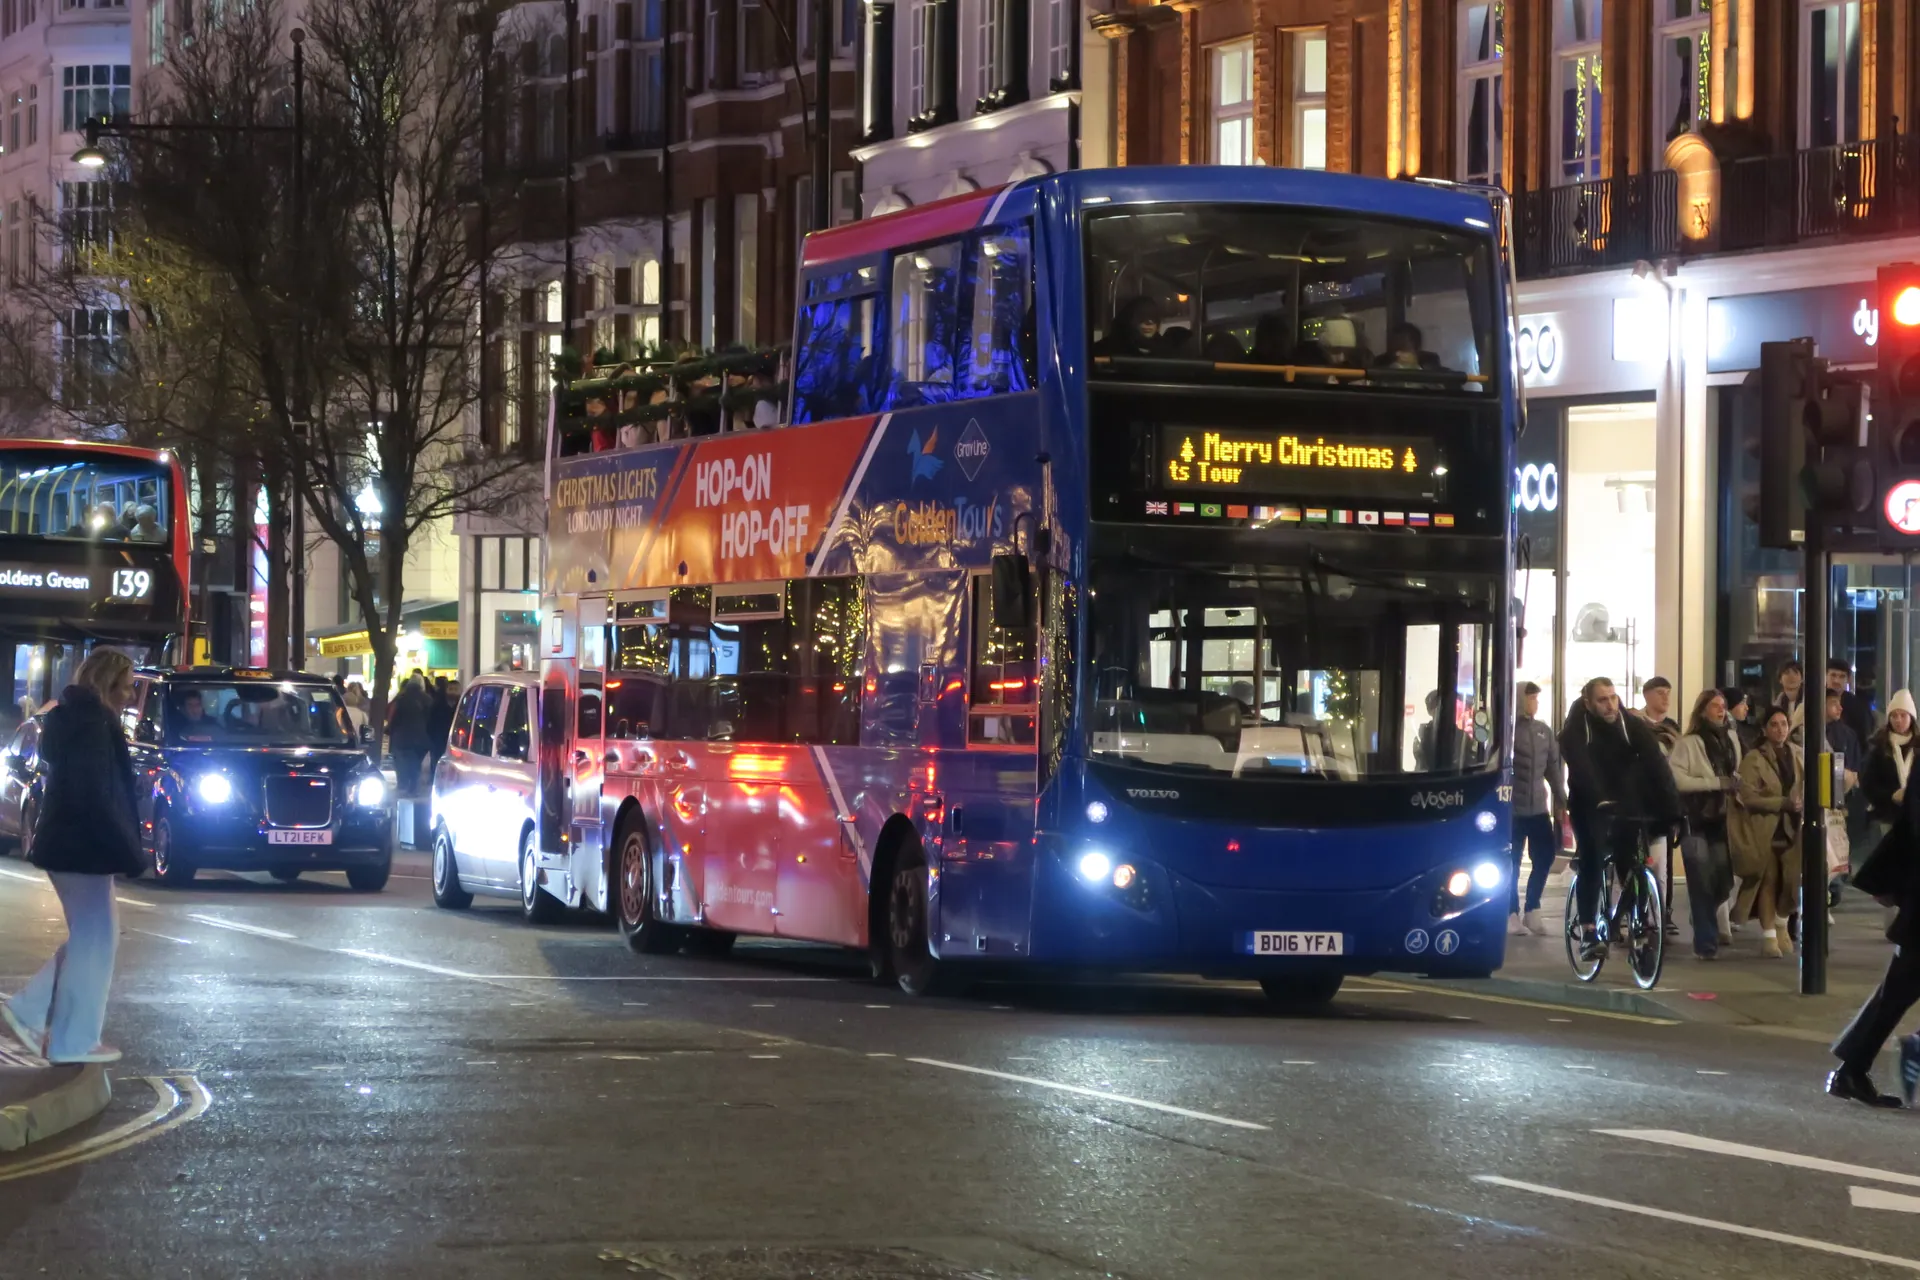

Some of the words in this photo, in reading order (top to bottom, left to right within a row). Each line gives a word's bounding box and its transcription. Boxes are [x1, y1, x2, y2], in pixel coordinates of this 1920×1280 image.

[1204, 432, 1272, 464] Merry
[1278, 436, 1394, 469] Christmas
[696, 452, 771, 508] HOP-ON
[1169, 460, 1190, 481] ts
[1198, 461, 1242, 483] Tour
[557, 472, 616, 508] CHRISTMAS
[618, 467, 657, 501] LIGHTS
[568, 509, 601, 534] LONDON
[603, 507, 615, 531] BY
[616, 505, 643, 528] NIGHT
[721, 504, 810, 559] HOP-OFF
[46, 571, 90, 590] Green
[113, 570, 150, 597] 139
[1126, 788, 1180, 800] VOLVO
[303, 831, 325, 843] EFK
[1260, 934, 1299, 952] BD16
[1304, 935, 1337, 952] YFA
